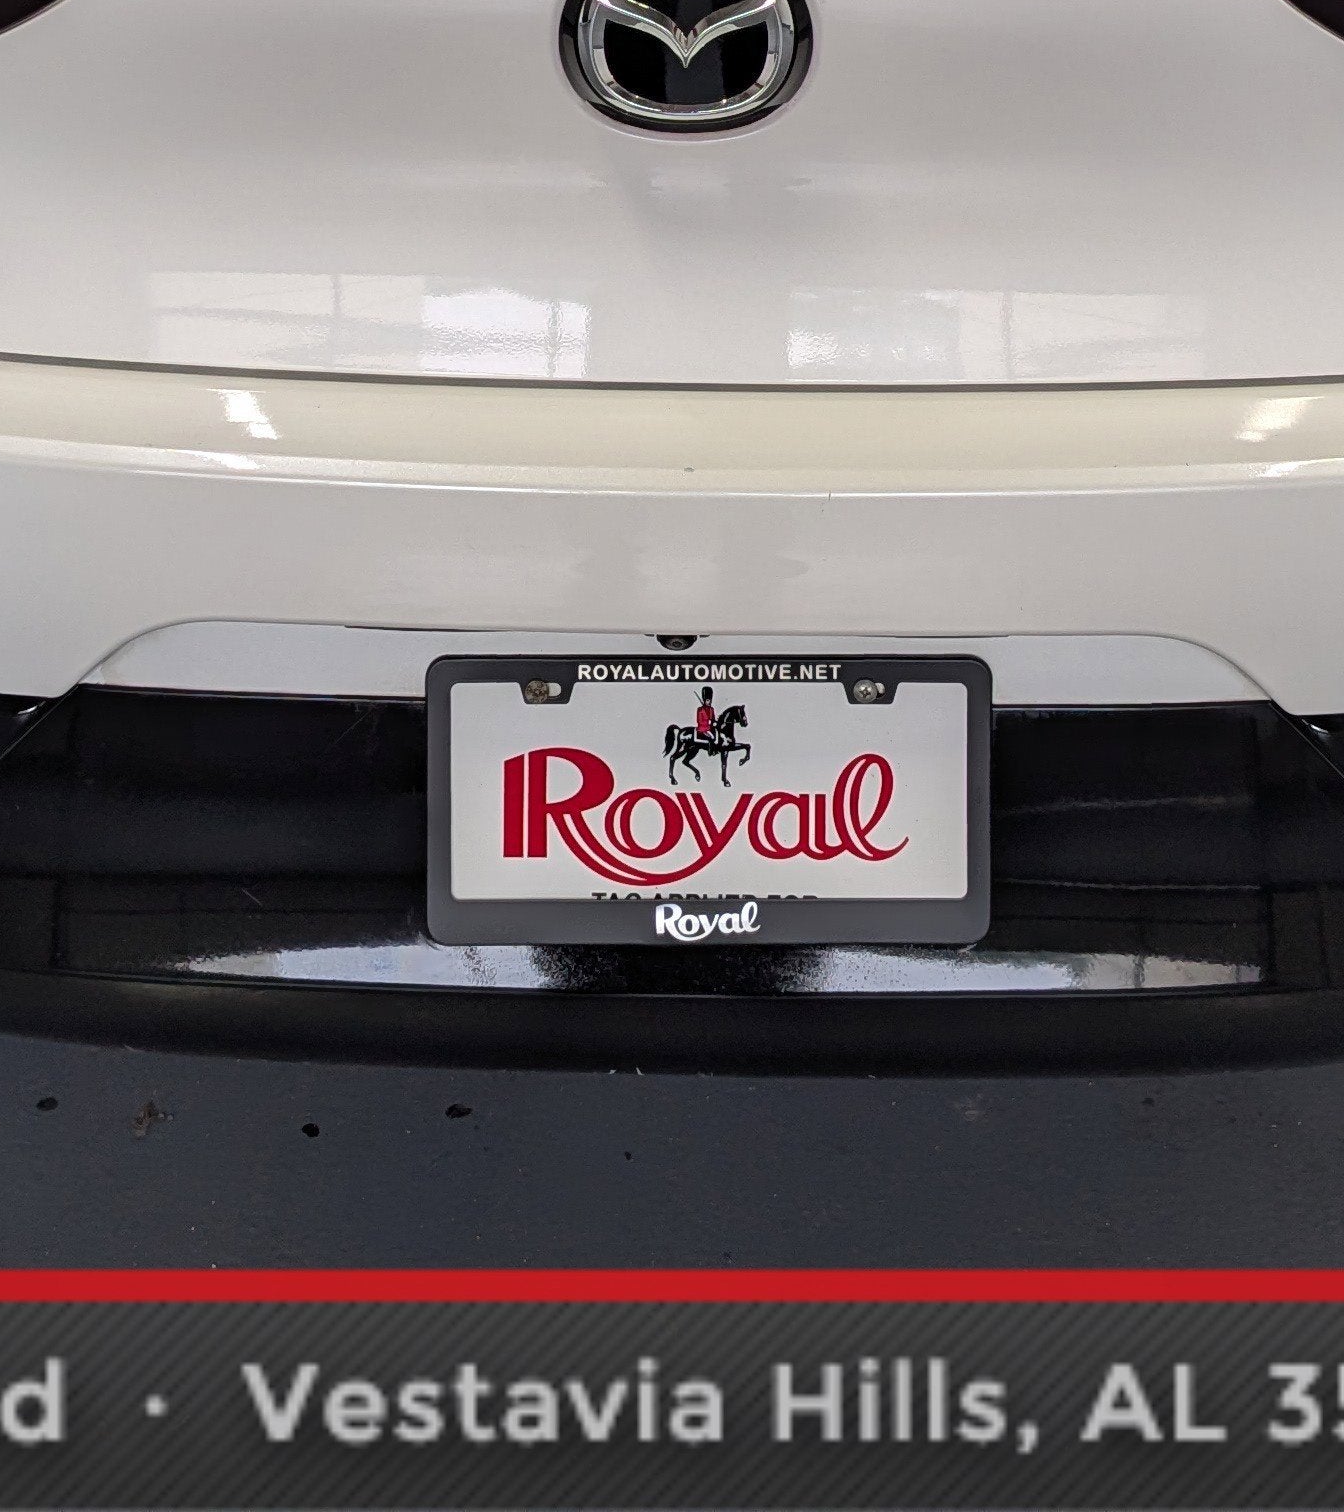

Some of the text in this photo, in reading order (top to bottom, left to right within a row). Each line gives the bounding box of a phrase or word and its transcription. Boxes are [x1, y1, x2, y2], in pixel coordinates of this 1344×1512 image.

[577, 663, 841, 683] ROYALAUTOMOTIVE.NET
[502, 746, 910, 887] Royal
[655, 900, 762, 942] Royal
